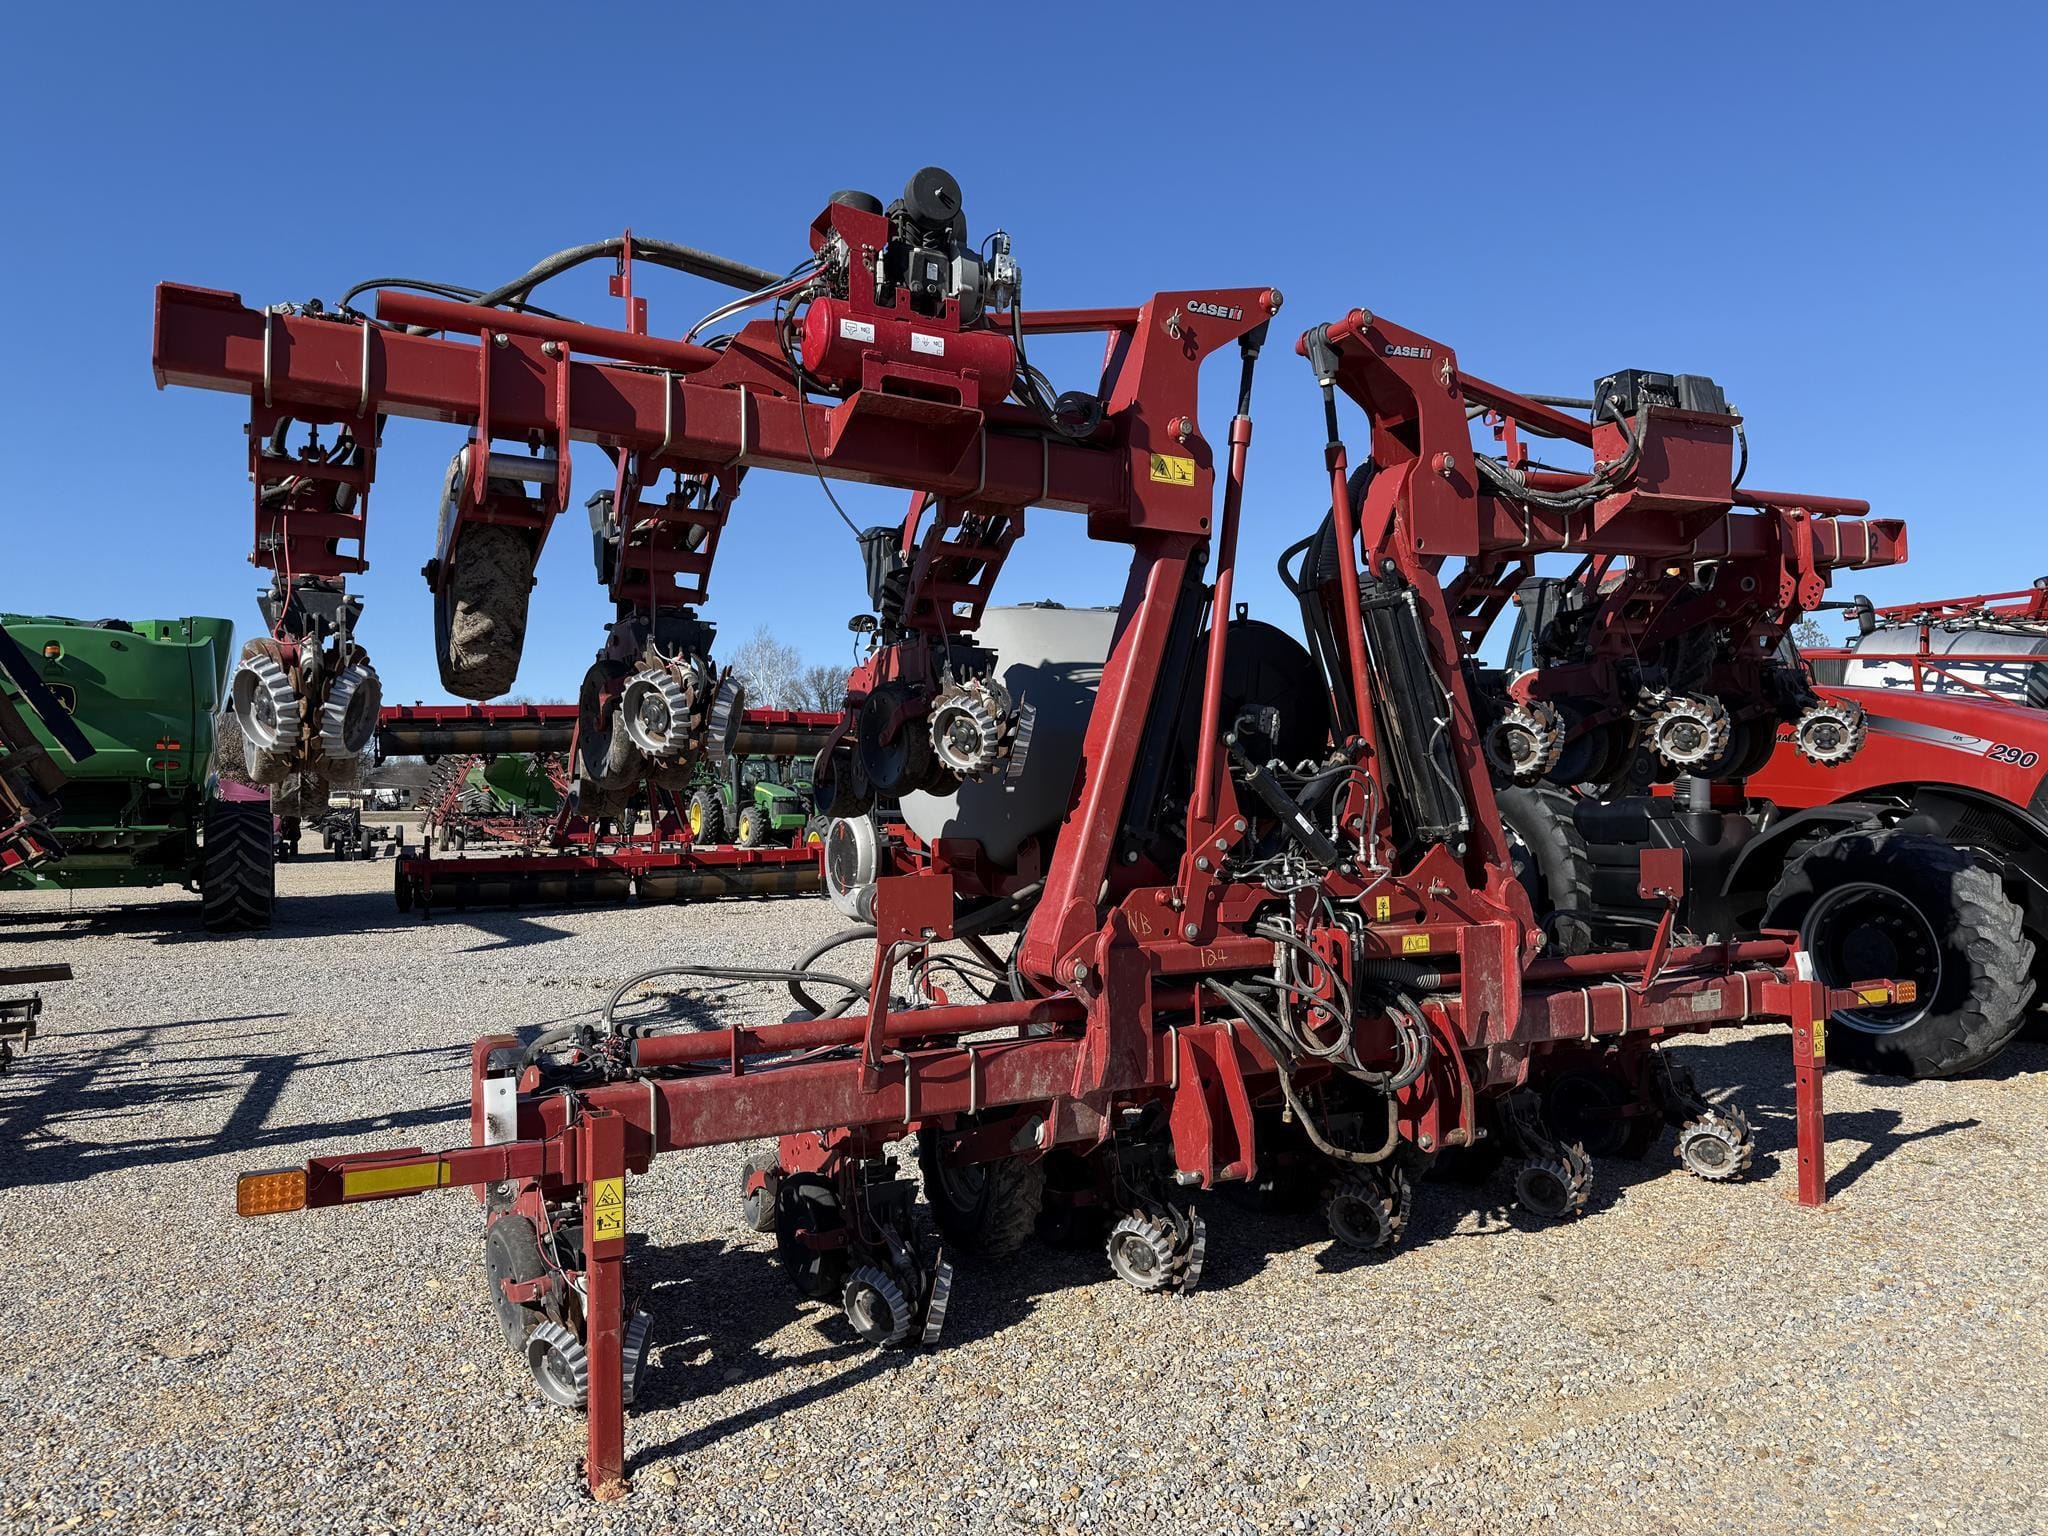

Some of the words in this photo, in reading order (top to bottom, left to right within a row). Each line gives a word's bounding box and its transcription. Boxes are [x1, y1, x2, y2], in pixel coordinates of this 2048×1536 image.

[1187, 300, 1229, 318] CASE
[1384, 344, 1420, 358] CASE
[1987, 744, 2039, 768] 290
[1127, 910, 1152, 936] NB
[1200, 947, 1228, 968] 124
